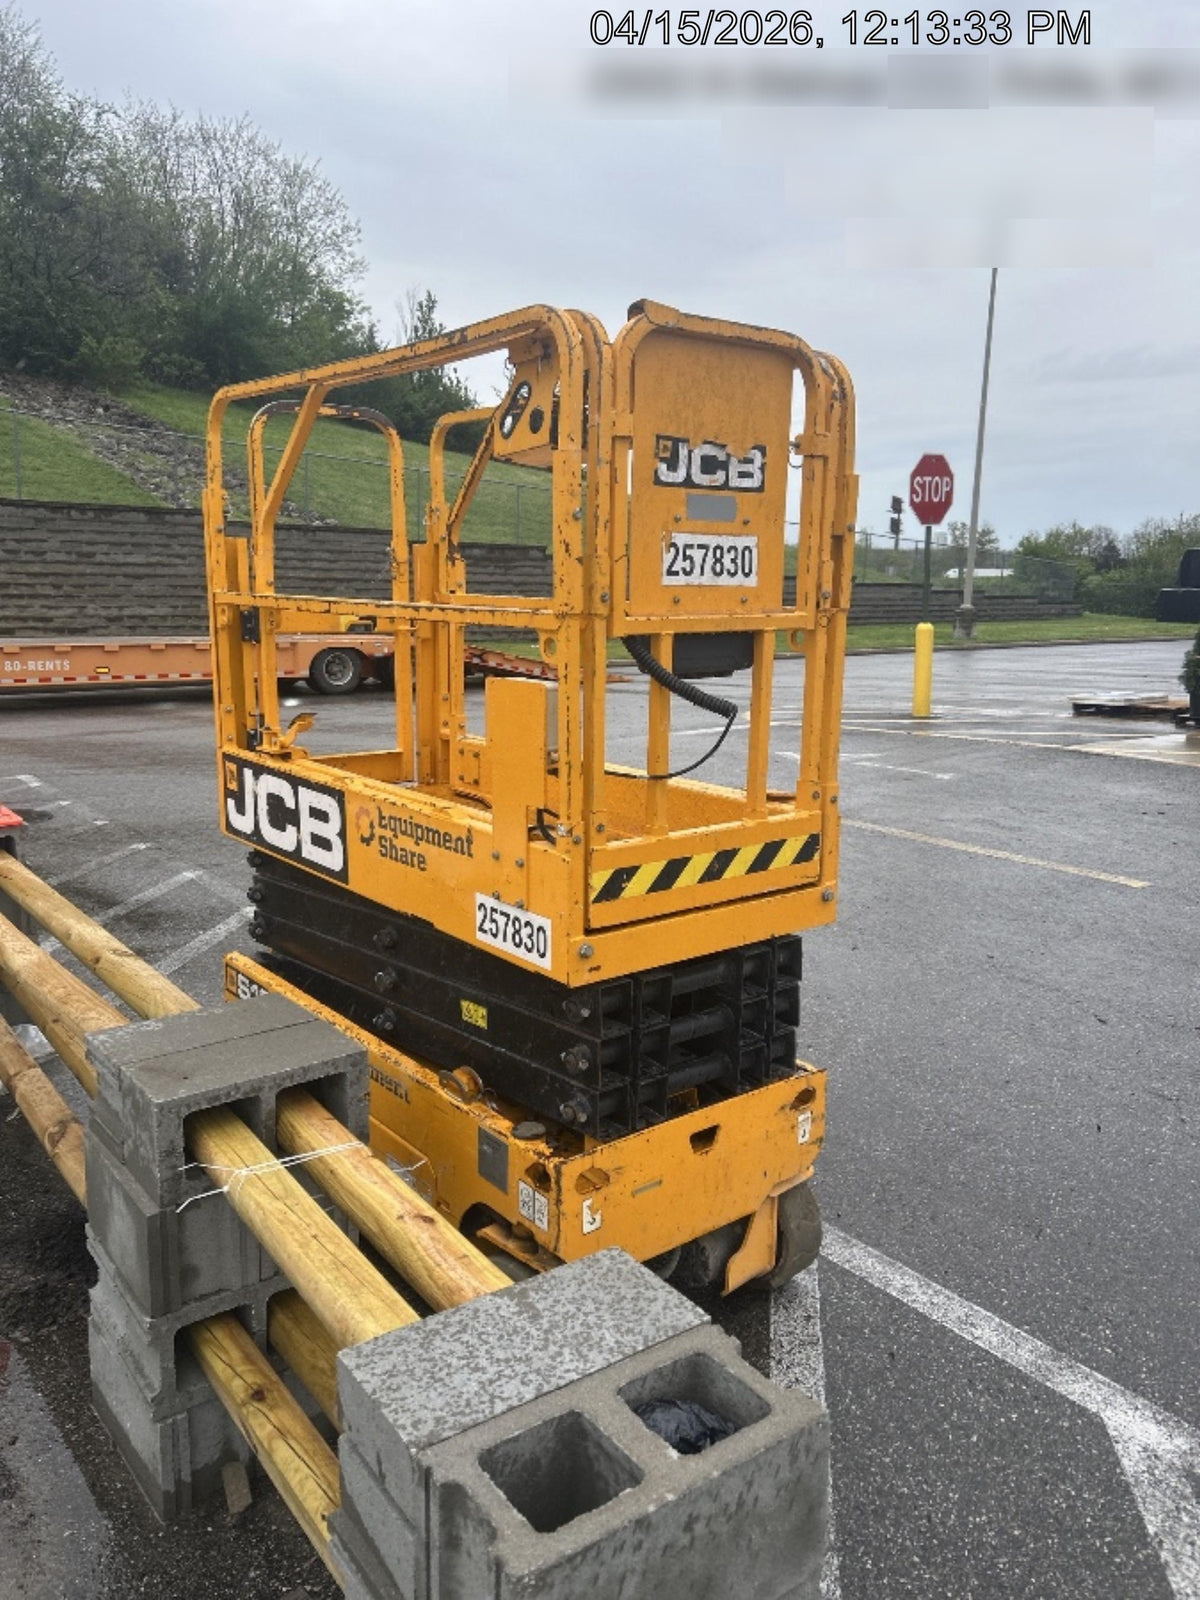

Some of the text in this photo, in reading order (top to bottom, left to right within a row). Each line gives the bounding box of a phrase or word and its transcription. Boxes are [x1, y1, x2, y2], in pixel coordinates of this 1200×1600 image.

[656, 441, 765, 489] JCB
[911, 475, 952, 503] STOP
[665, 542, 754, 578] 257830
[226, 766, 344, 873] JCB
[377, 805, 474, 859] Equipment
[379, 834, 427, 872] Share
[477, 902, 547, 959] 257830
